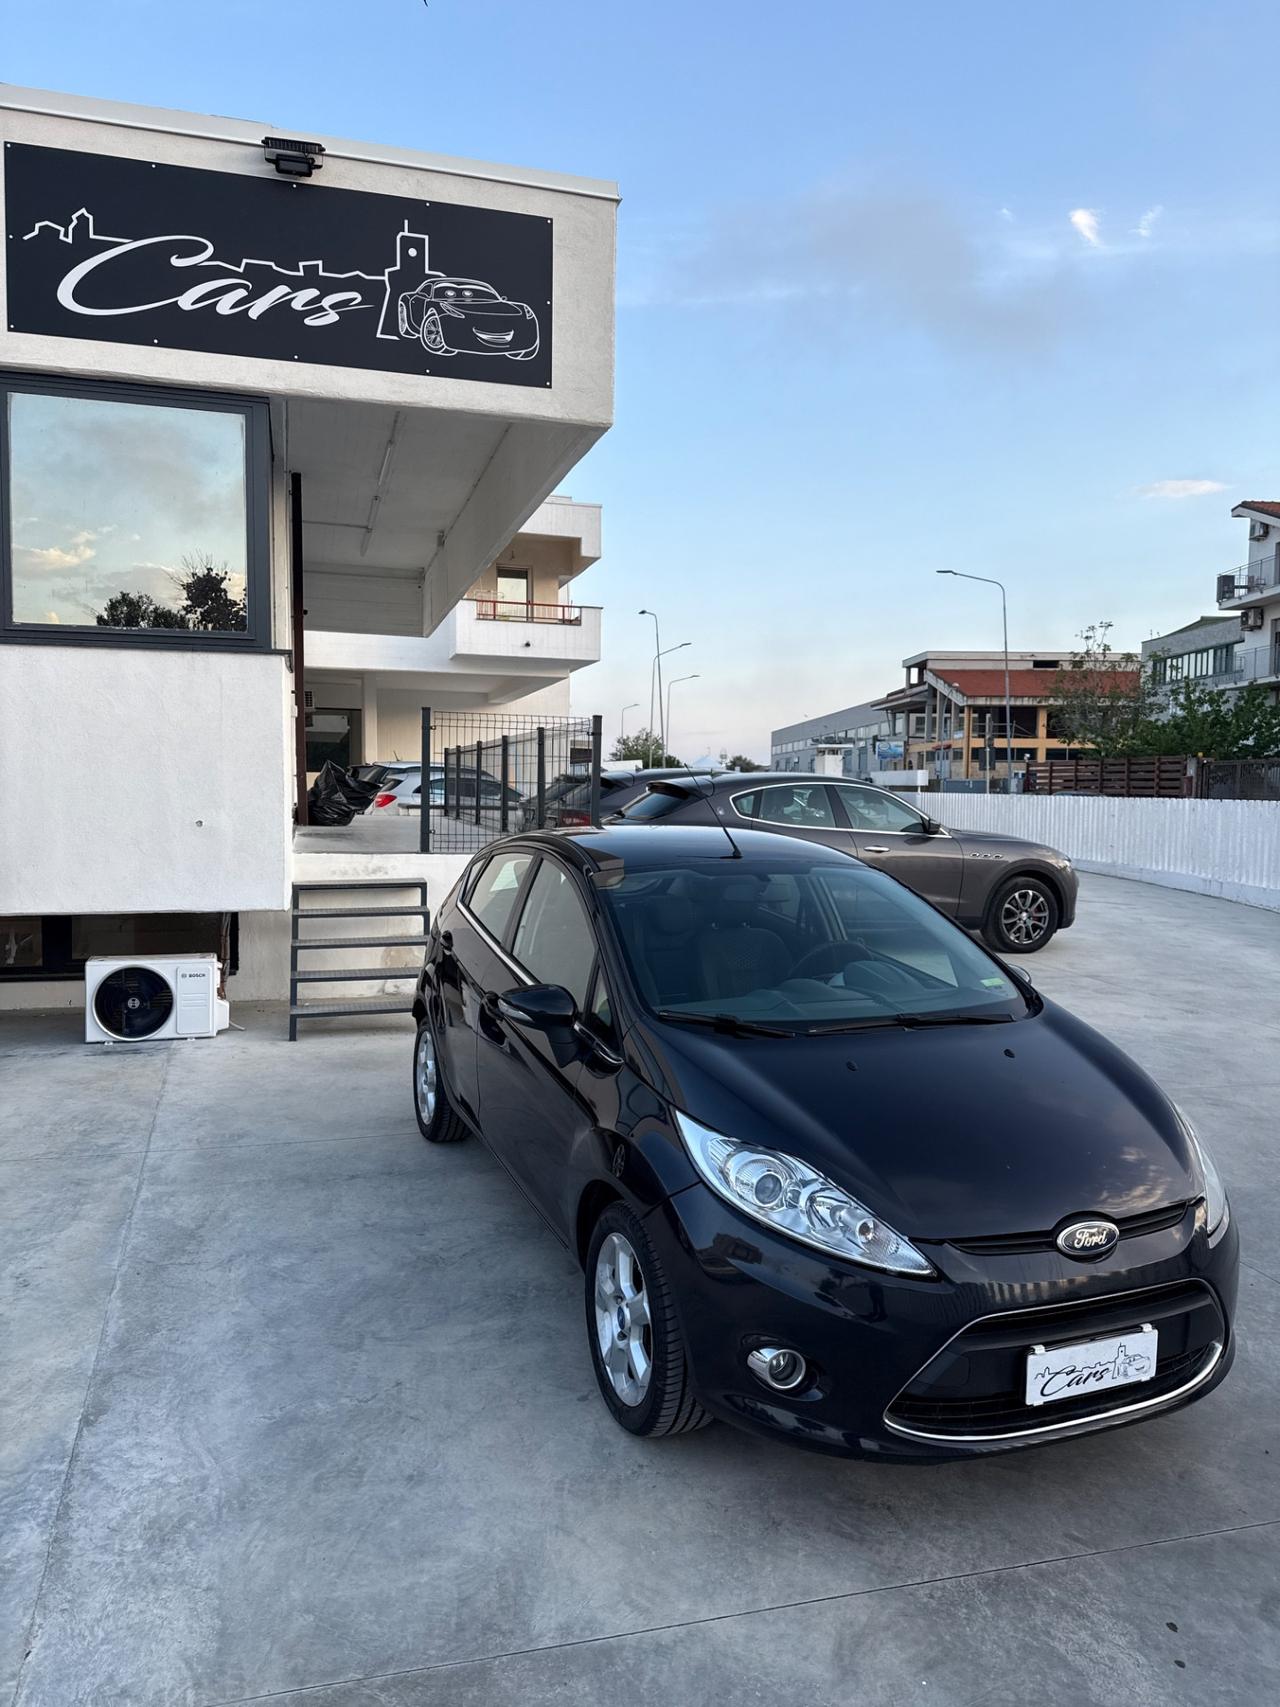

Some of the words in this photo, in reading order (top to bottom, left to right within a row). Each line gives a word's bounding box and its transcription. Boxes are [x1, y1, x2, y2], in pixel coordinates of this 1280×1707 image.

[56, 234, 375, 327] Cars
[1073, 1227, 1109, 1249] Ford
[1039, 1364, 1113, 1397] Cars
